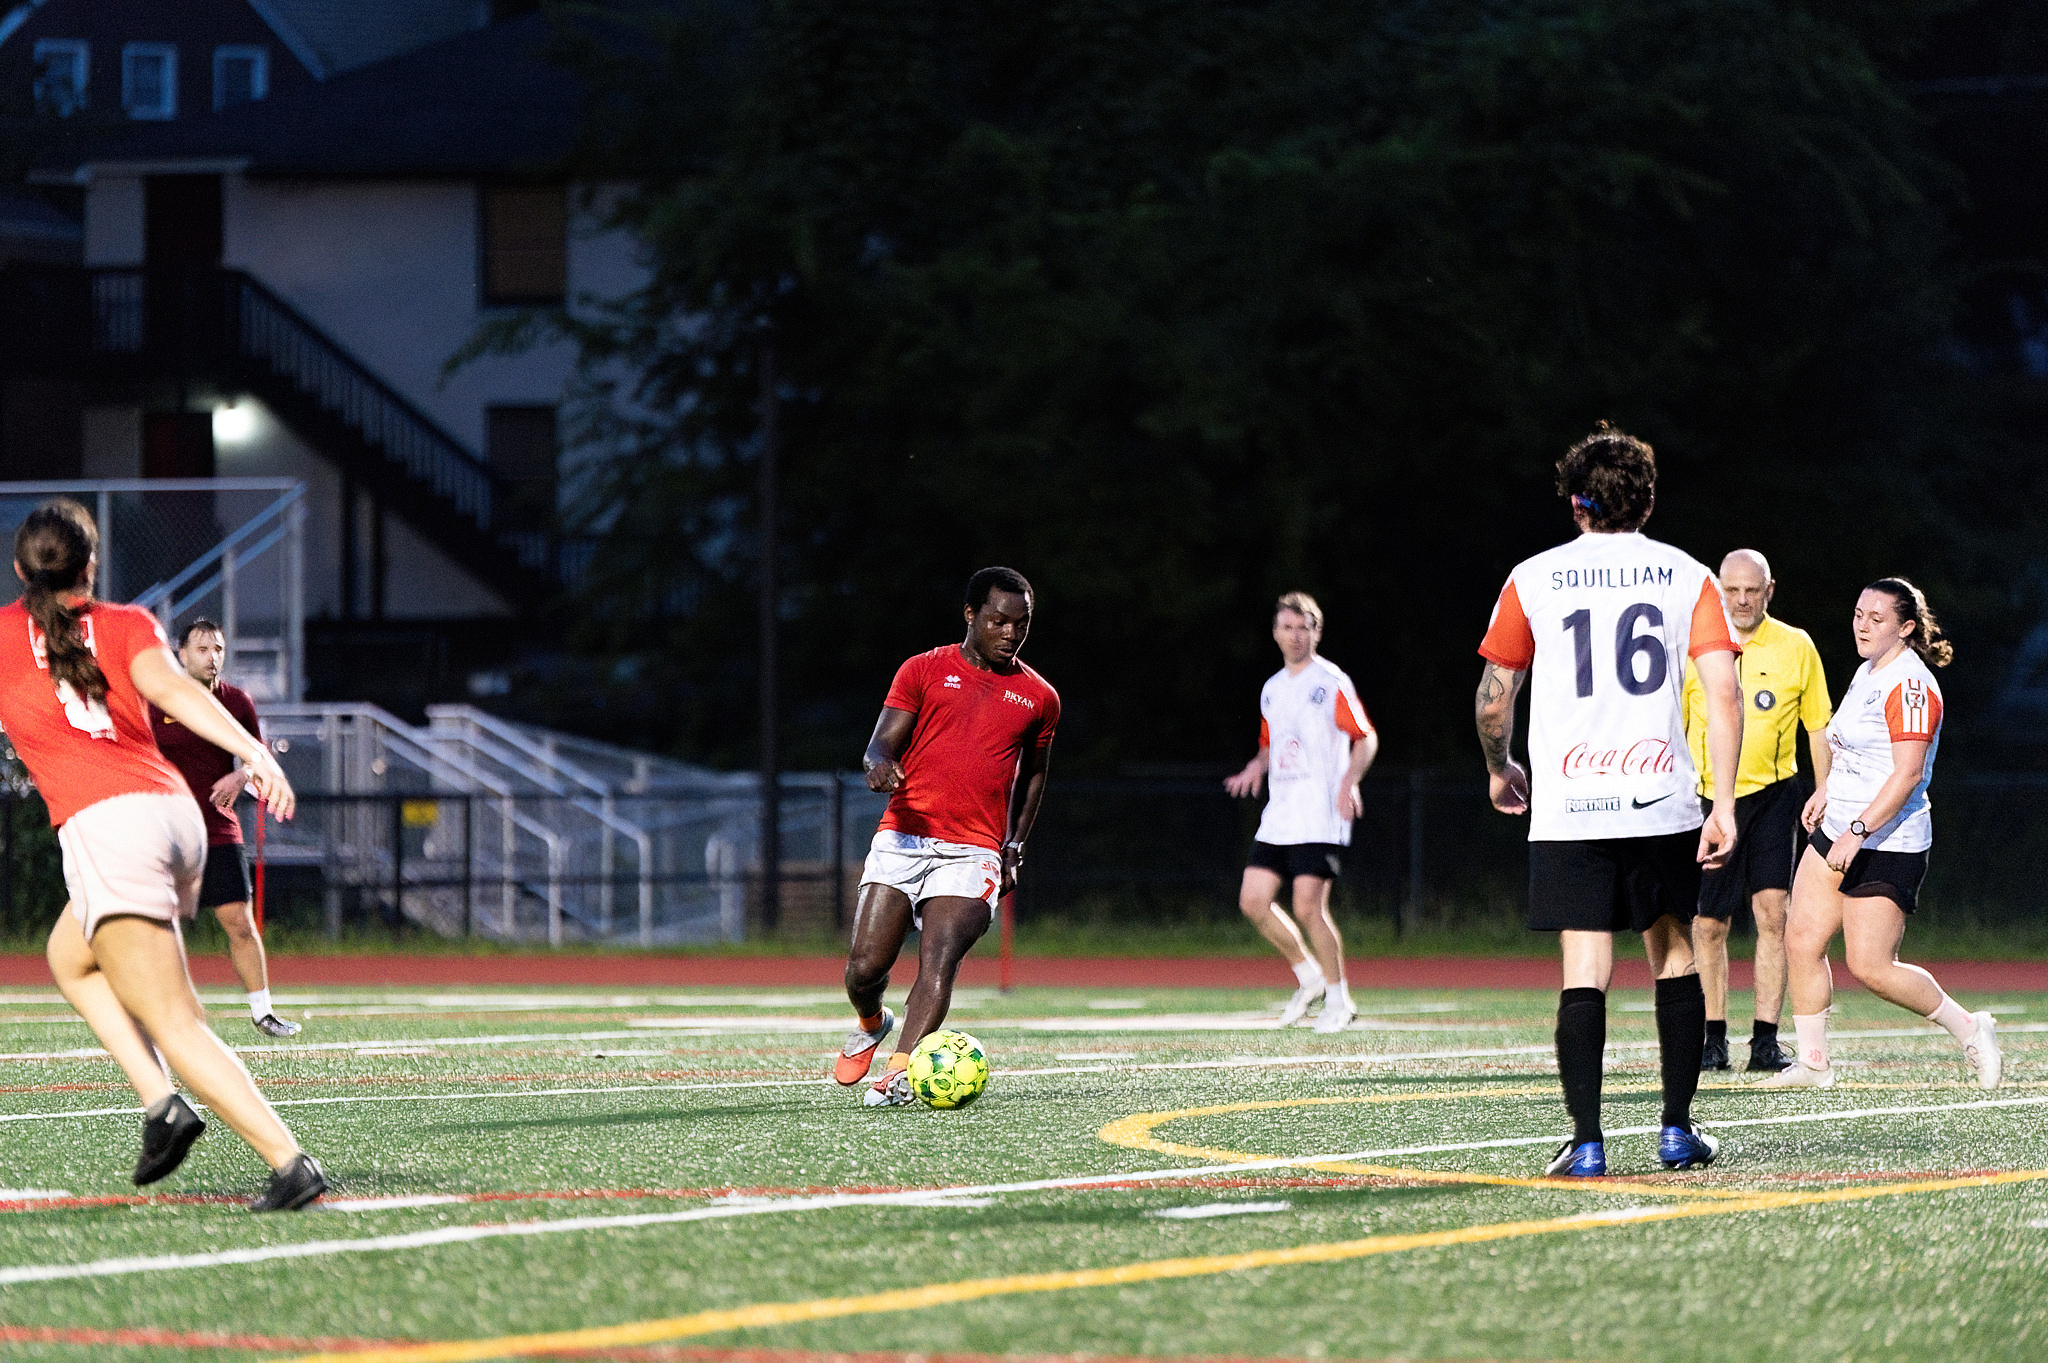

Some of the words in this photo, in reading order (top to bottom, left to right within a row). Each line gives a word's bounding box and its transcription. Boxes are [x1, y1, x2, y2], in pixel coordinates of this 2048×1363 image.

[1552, 566, 1672, 590] SQUILLIAM
[1562, 603, 1667, 698] 16
[1004, 690, 1034, 709] BRYAN
[1566, 797, 1620, 813] FORTNITE
[980, 877, 996, 901] 7
